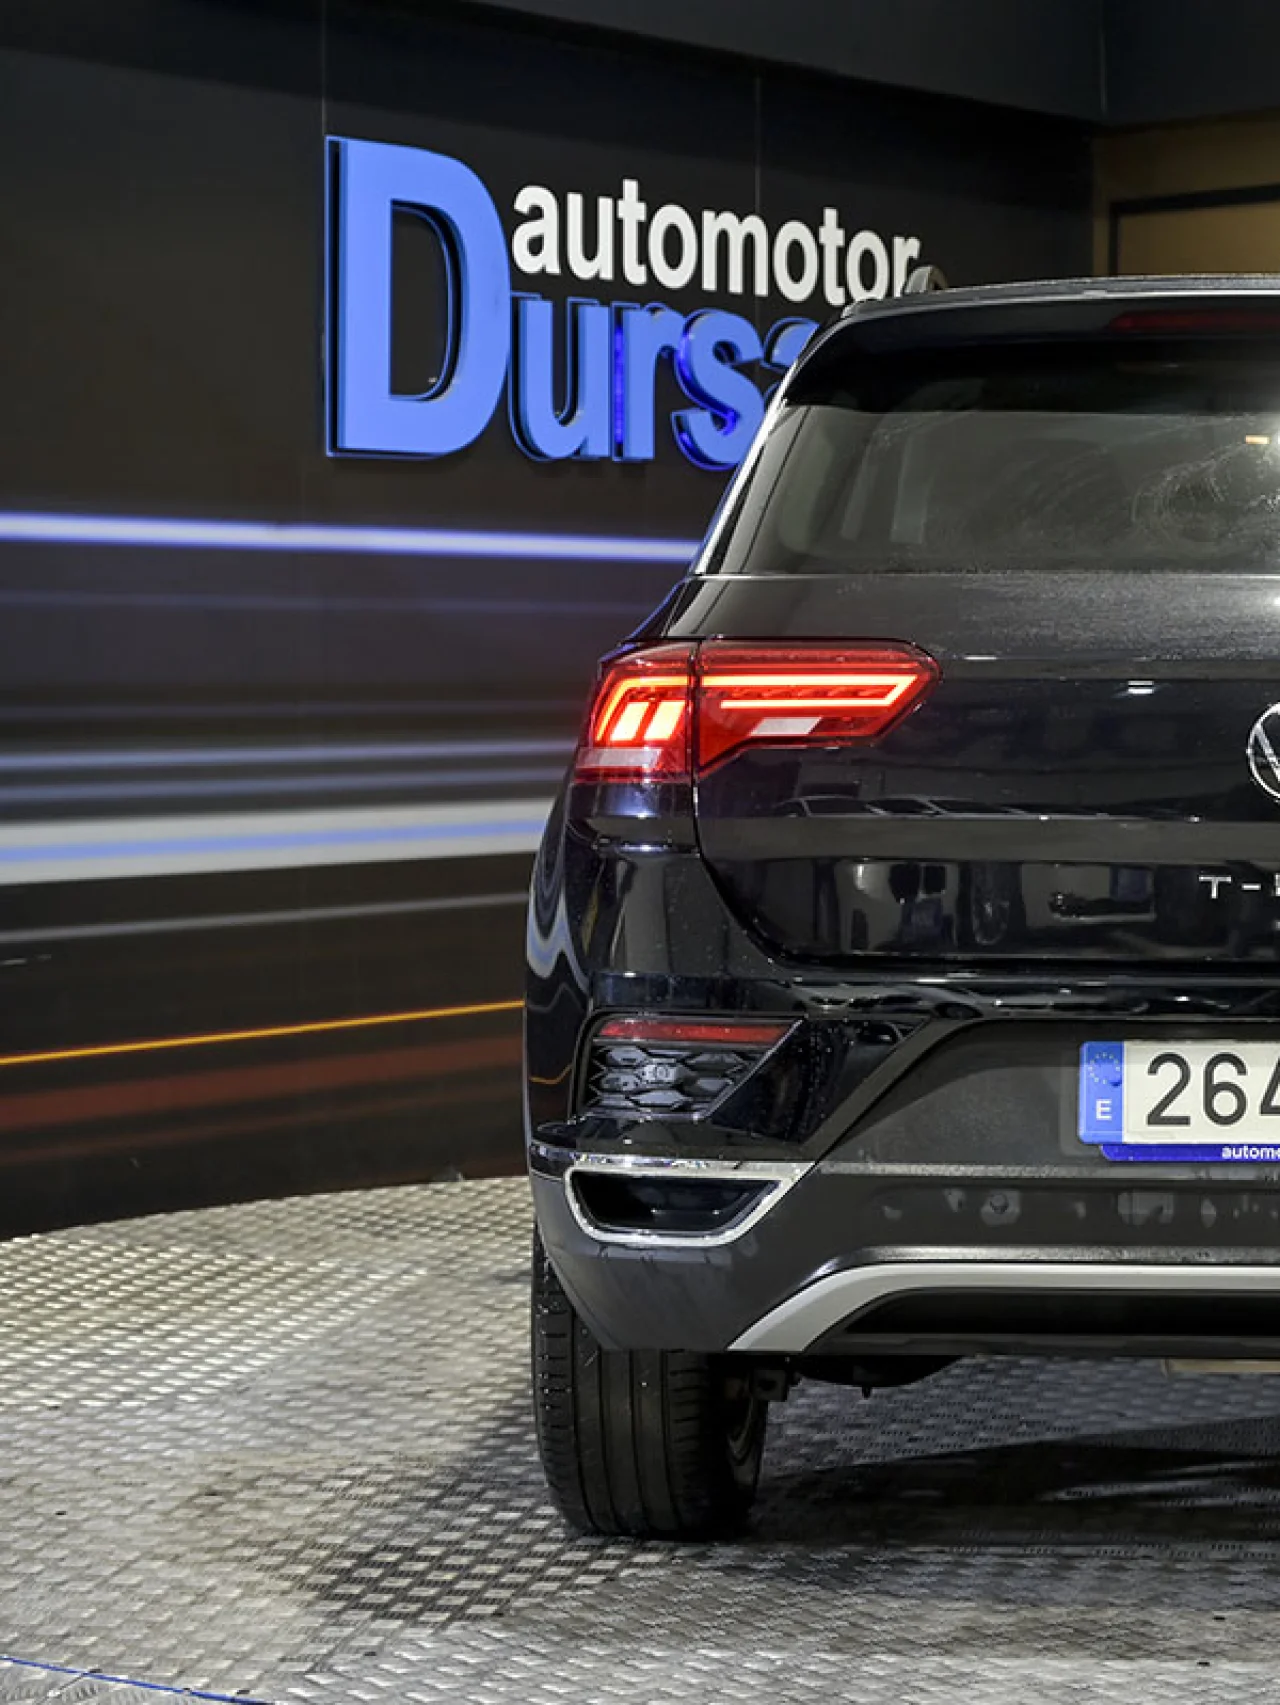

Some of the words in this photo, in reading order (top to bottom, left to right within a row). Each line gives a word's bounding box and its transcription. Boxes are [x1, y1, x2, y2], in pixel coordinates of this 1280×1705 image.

[325, 135, 820, 471] Durs
[511, 178, 921, 305] automotor
[1095, 1099, 1112, 1121] E
